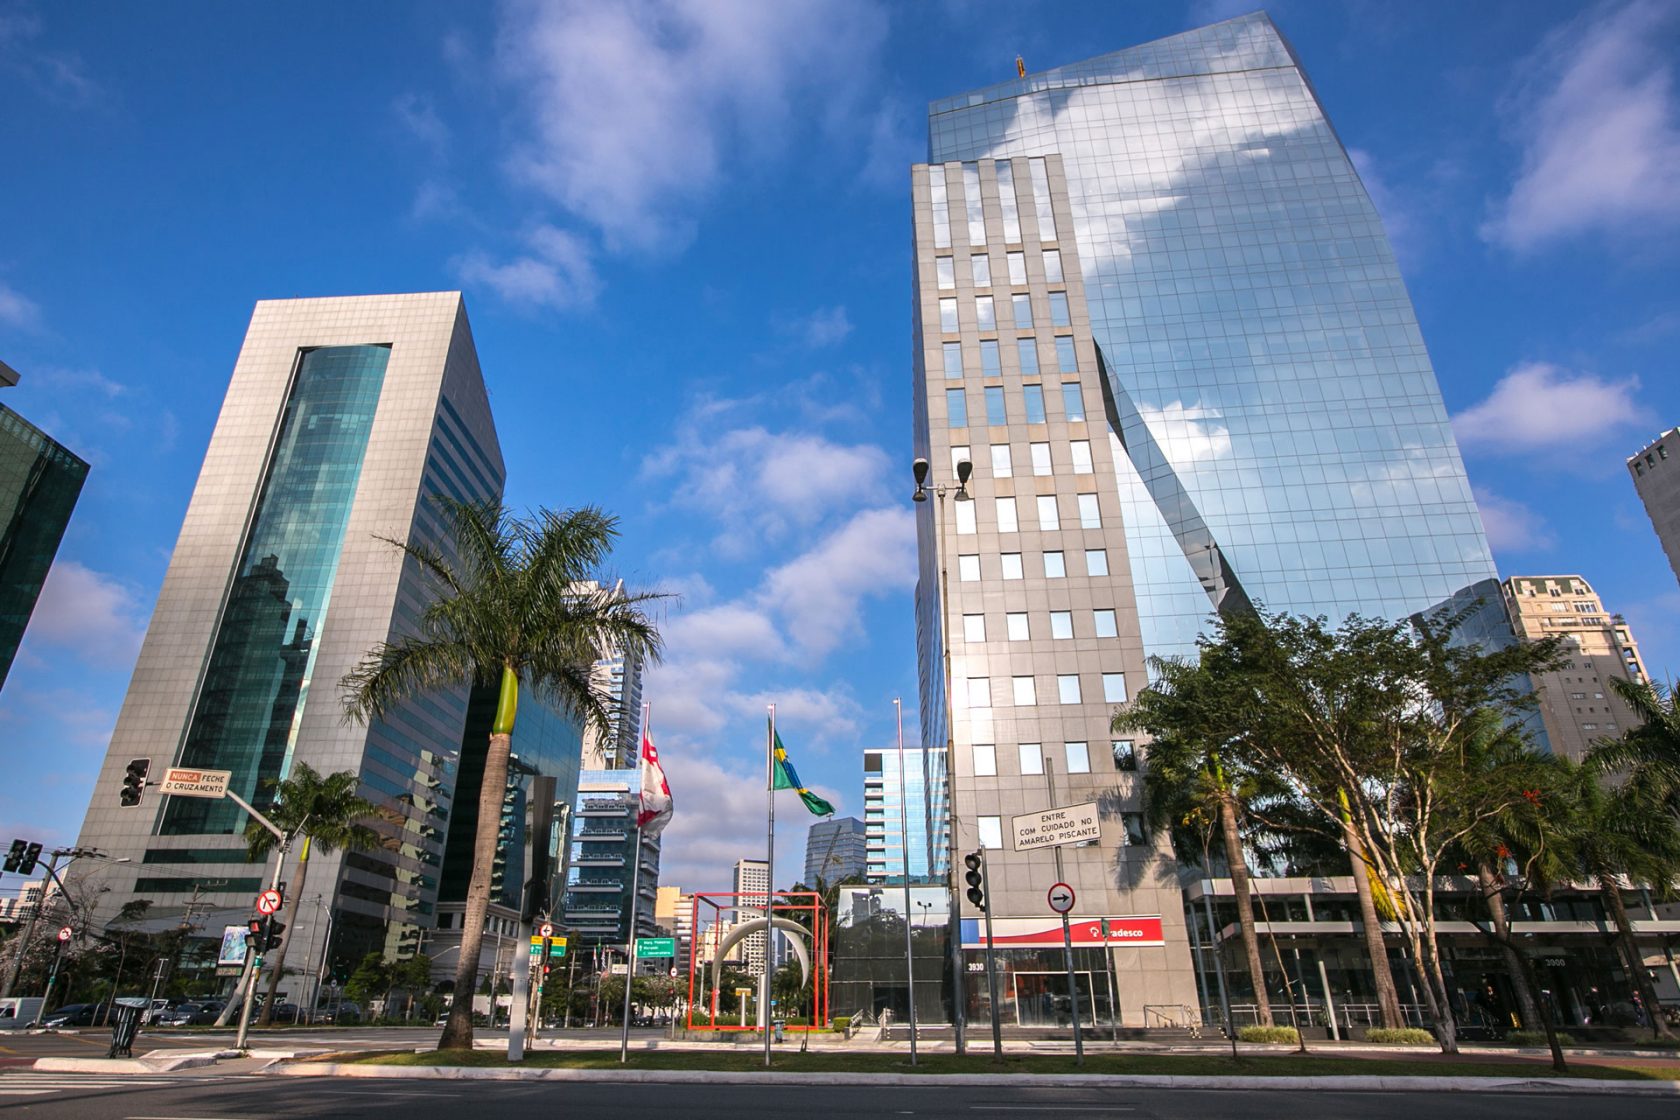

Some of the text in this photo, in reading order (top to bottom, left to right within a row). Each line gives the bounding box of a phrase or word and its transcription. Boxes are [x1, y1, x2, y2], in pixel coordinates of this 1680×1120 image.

[171, 772, 225, 783] NUNCA FECHE
[174, 782, 223, 792] CRUZAMENTO
[1041, 812, 1066, 823] ENTRE
[1019, 817, 1093, 836] COM CUIDADO NO
[1019, 827, 1097, 846] AMARELO PISCANTE
[254, 994, 288, 1006] Sara
